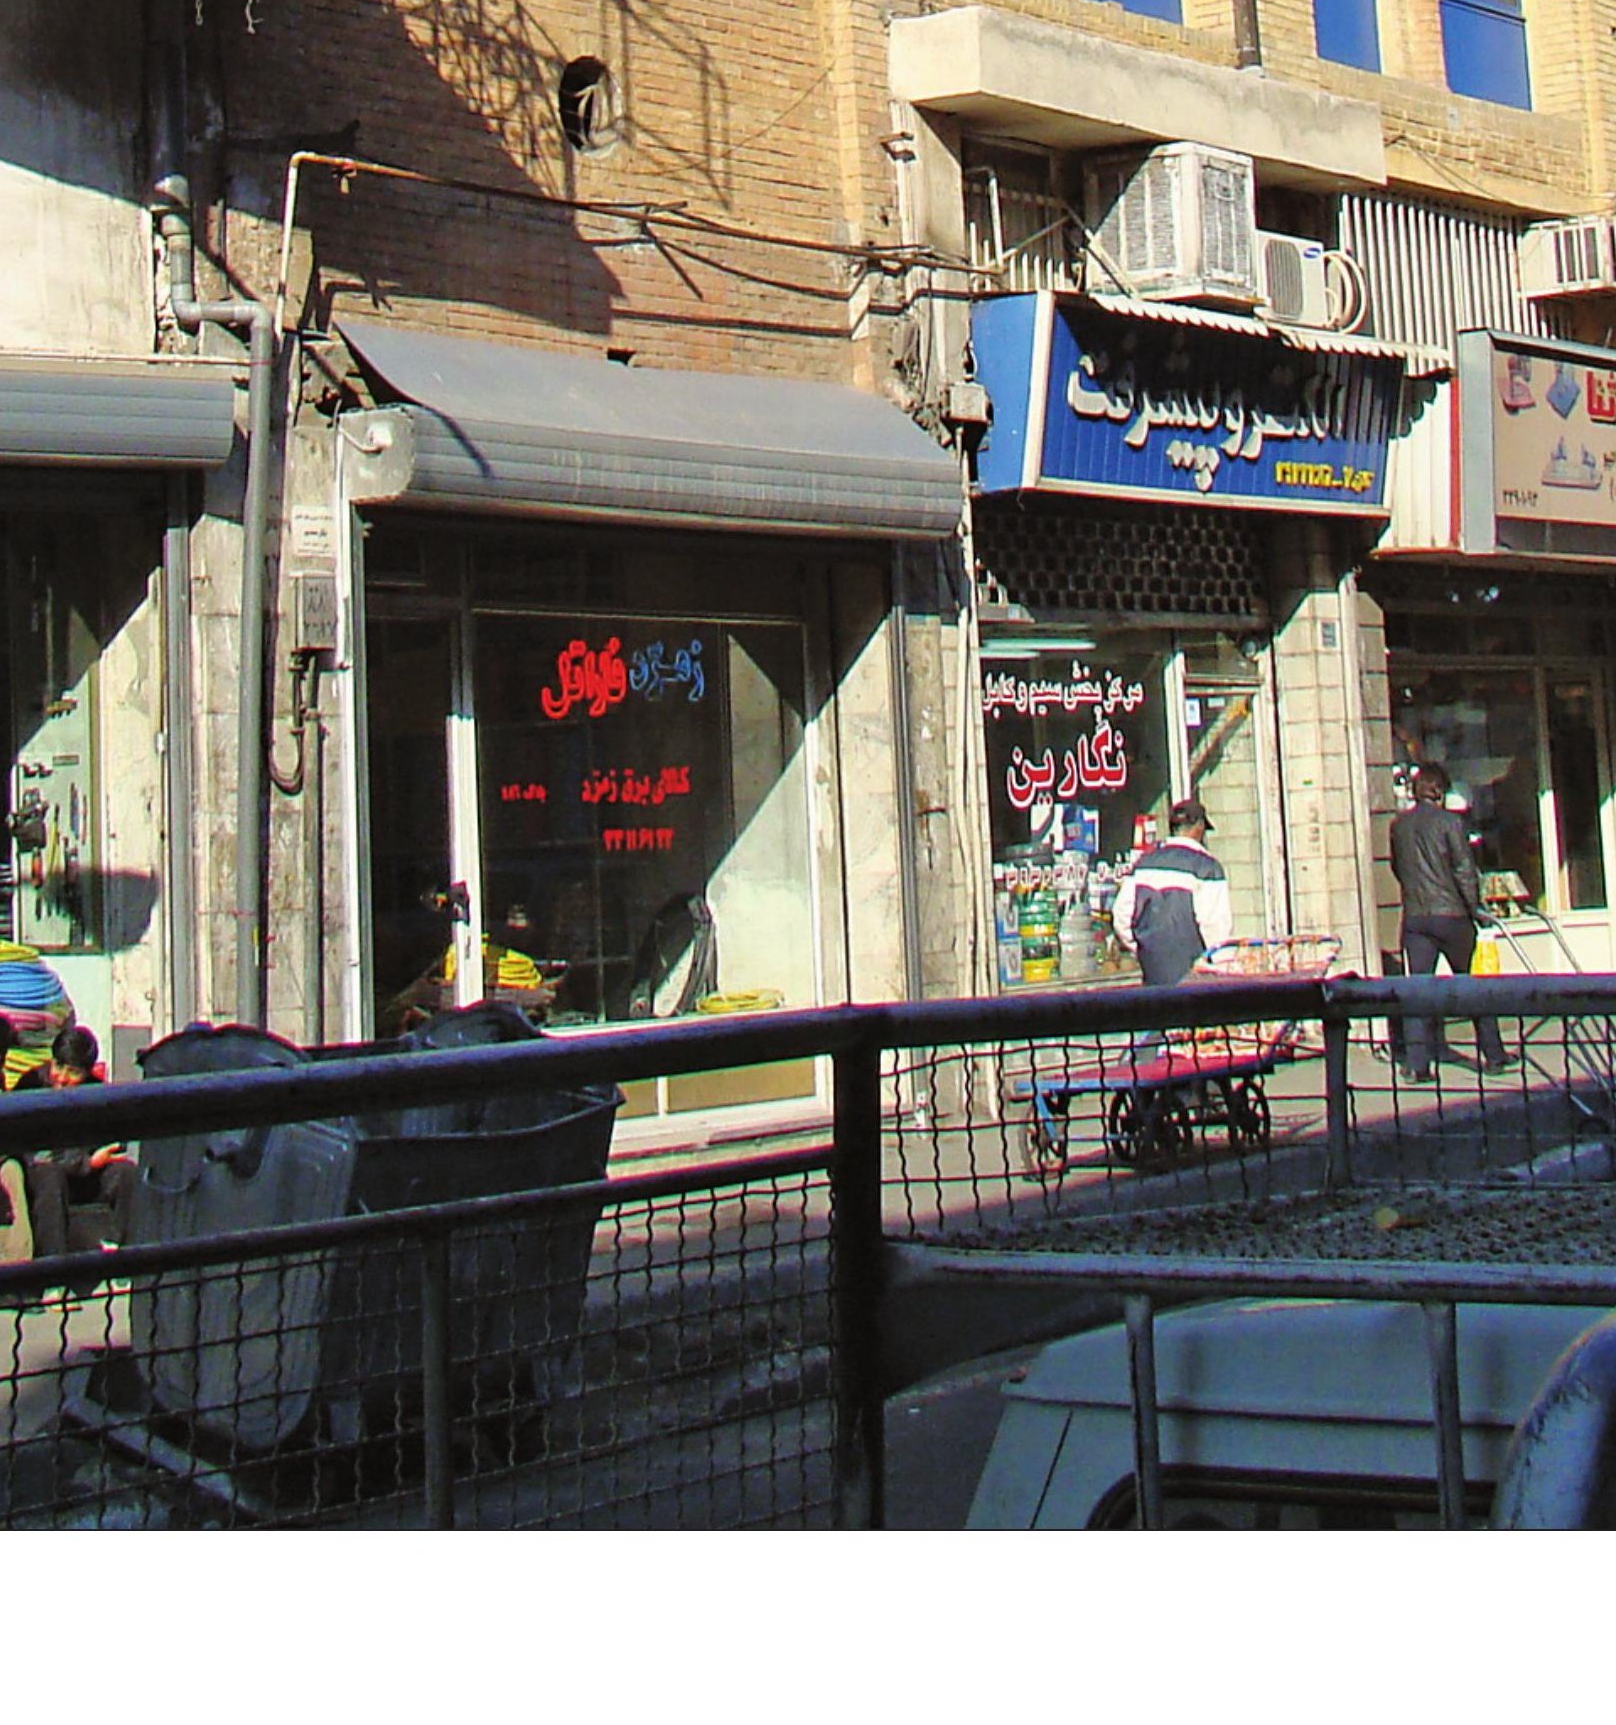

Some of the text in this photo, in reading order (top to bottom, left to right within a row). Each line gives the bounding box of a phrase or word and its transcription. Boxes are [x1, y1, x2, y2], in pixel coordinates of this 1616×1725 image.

[983, 659, 1143, 723] مرکز پخش سیم و کابل
[1006, 718, 1129, 808] نگارین
